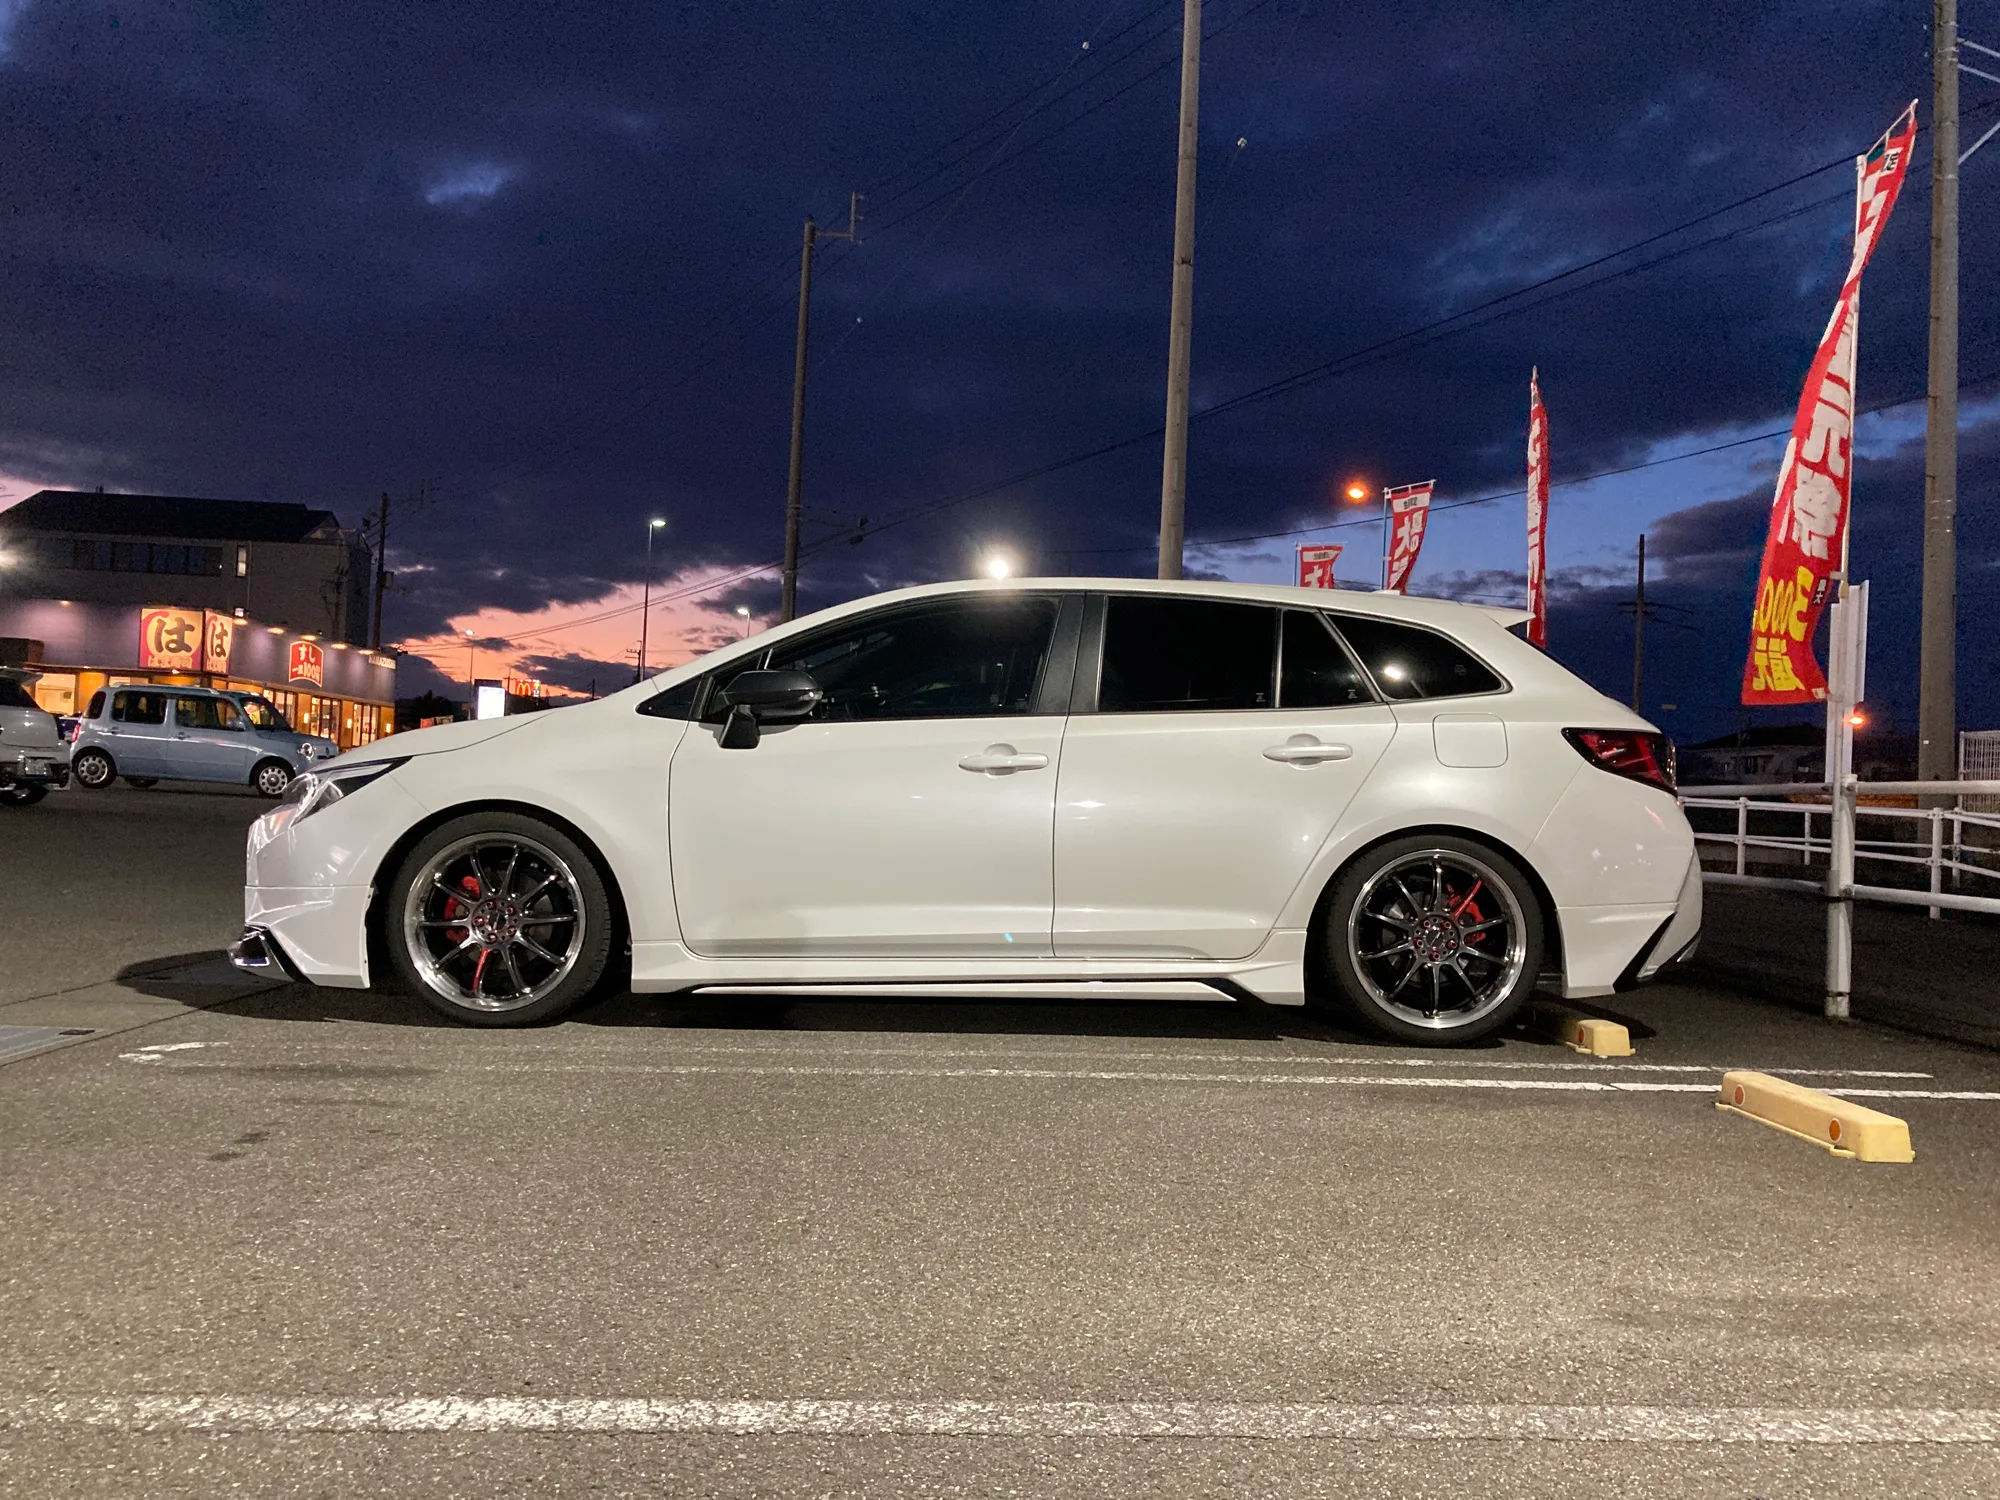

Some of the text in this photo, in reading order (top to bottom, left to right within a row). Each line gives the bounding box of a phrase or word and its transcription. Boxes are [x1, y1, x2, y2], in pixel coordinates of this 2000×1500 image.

[154, 617, 195, 653] は
[211, 622, 228, 657] は
[298, 643, 316, 663] すし
